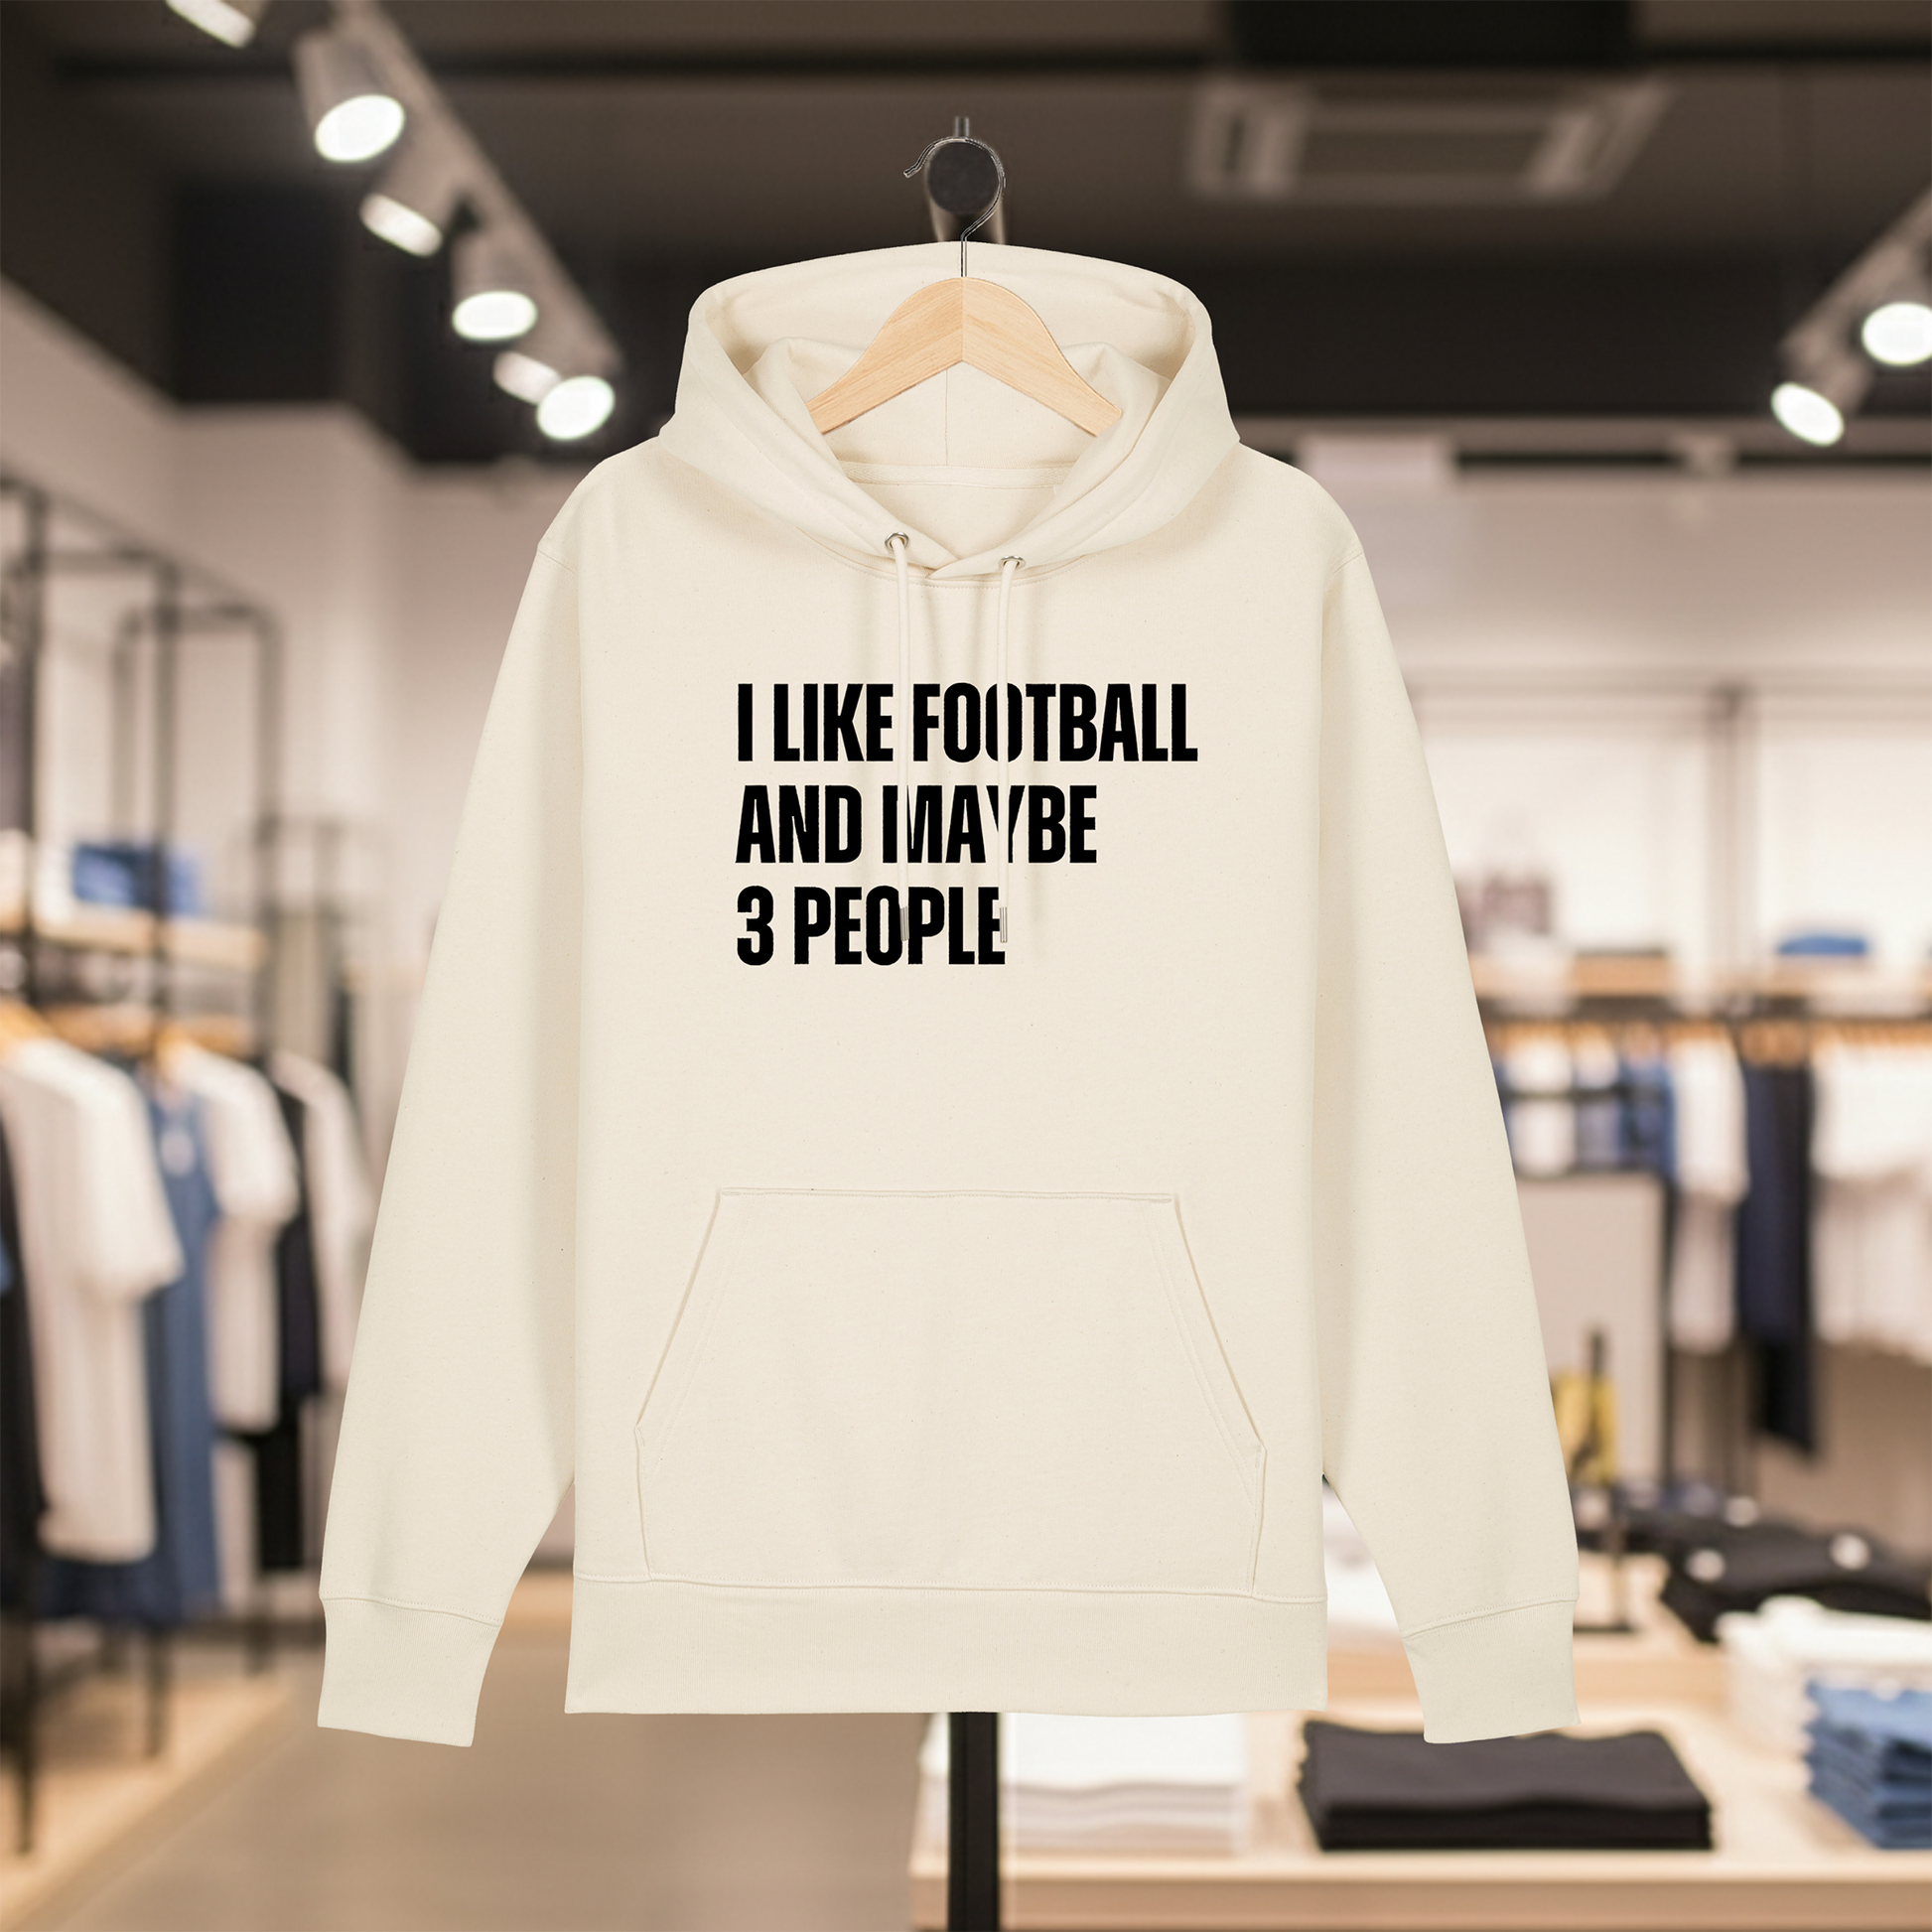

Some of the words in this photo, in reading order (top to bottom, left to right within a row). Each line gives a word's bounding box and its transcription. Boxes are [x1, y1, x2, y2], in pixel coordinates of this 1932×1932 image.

[738, 683, 754, 762] I
[773, 683, 894, 762] LIKE
[912, 682, 1198, 763] FOOTBALL
[735, 784, 863, 864] AND
[882, 784, 1097, 864] MAYBE
[737, 885, 774, 966] 3
[793, 885, 1006, 966] PEOPLE
